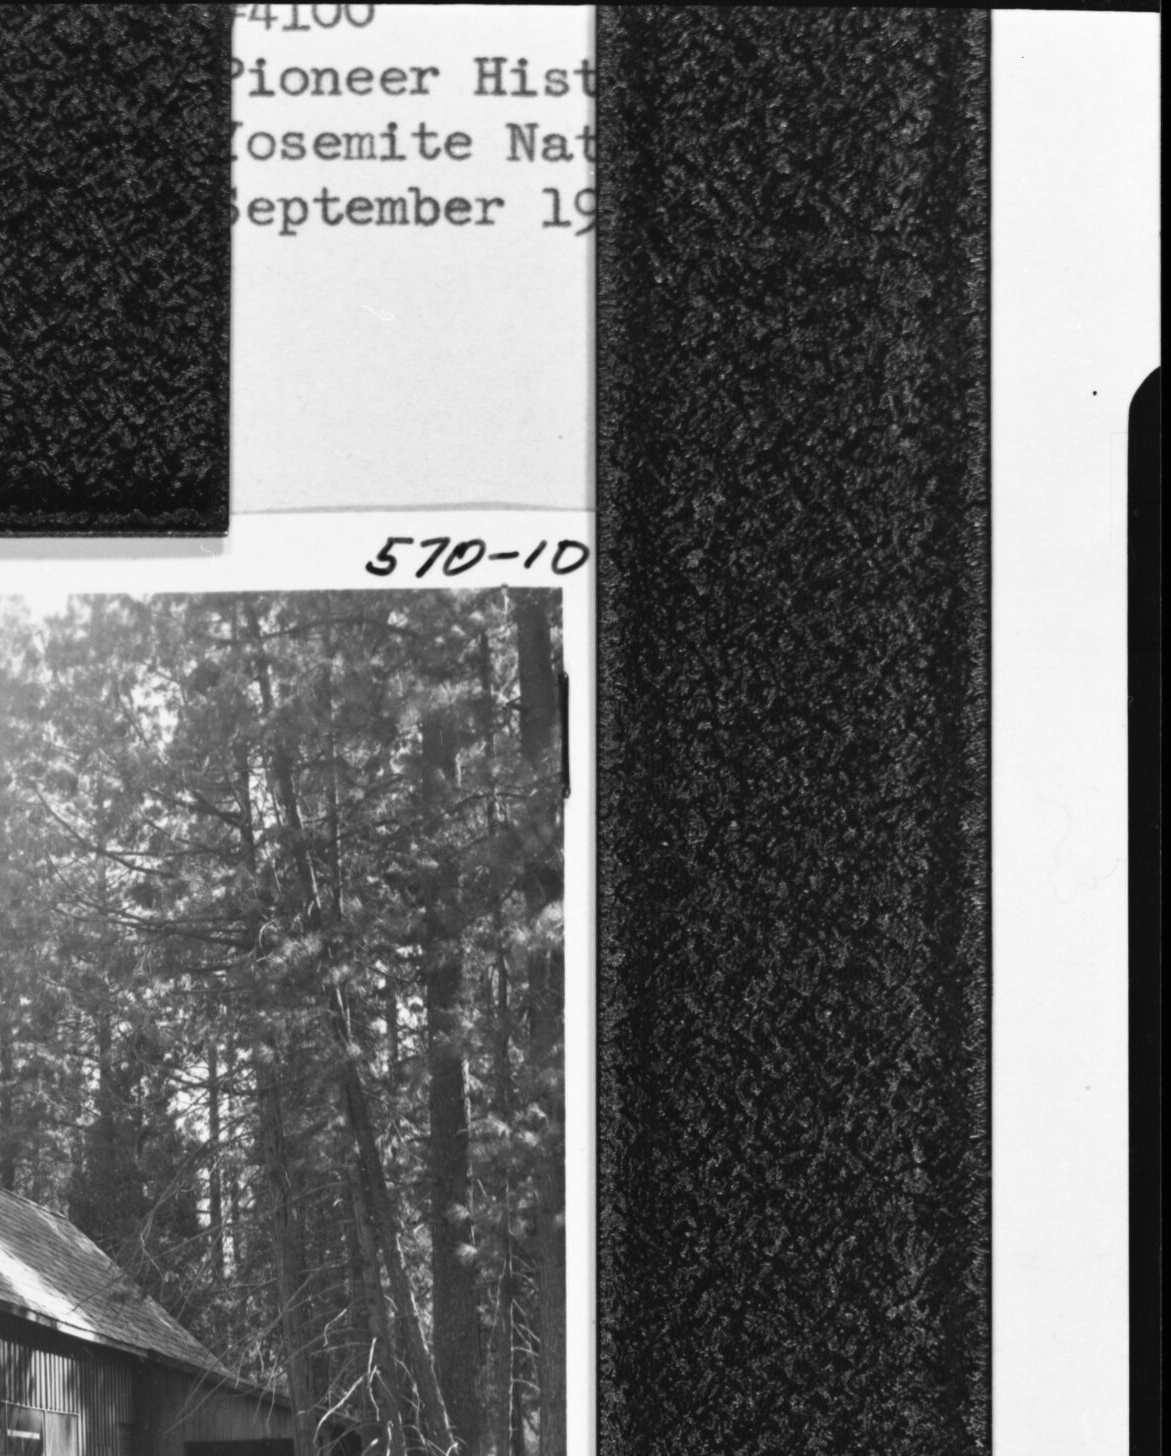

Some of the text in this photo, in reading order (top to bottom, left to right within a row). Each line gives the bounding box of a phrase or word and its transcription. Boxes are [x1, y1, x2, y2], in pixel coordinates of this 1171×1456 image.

[230, 4, 375, 31] 4100
[473, 57, 596, 97] Hist
[505, 122, 596, 162] Nat
[542, 187, 596, 237] 19
[365, 537, 590, 578] 570-10
